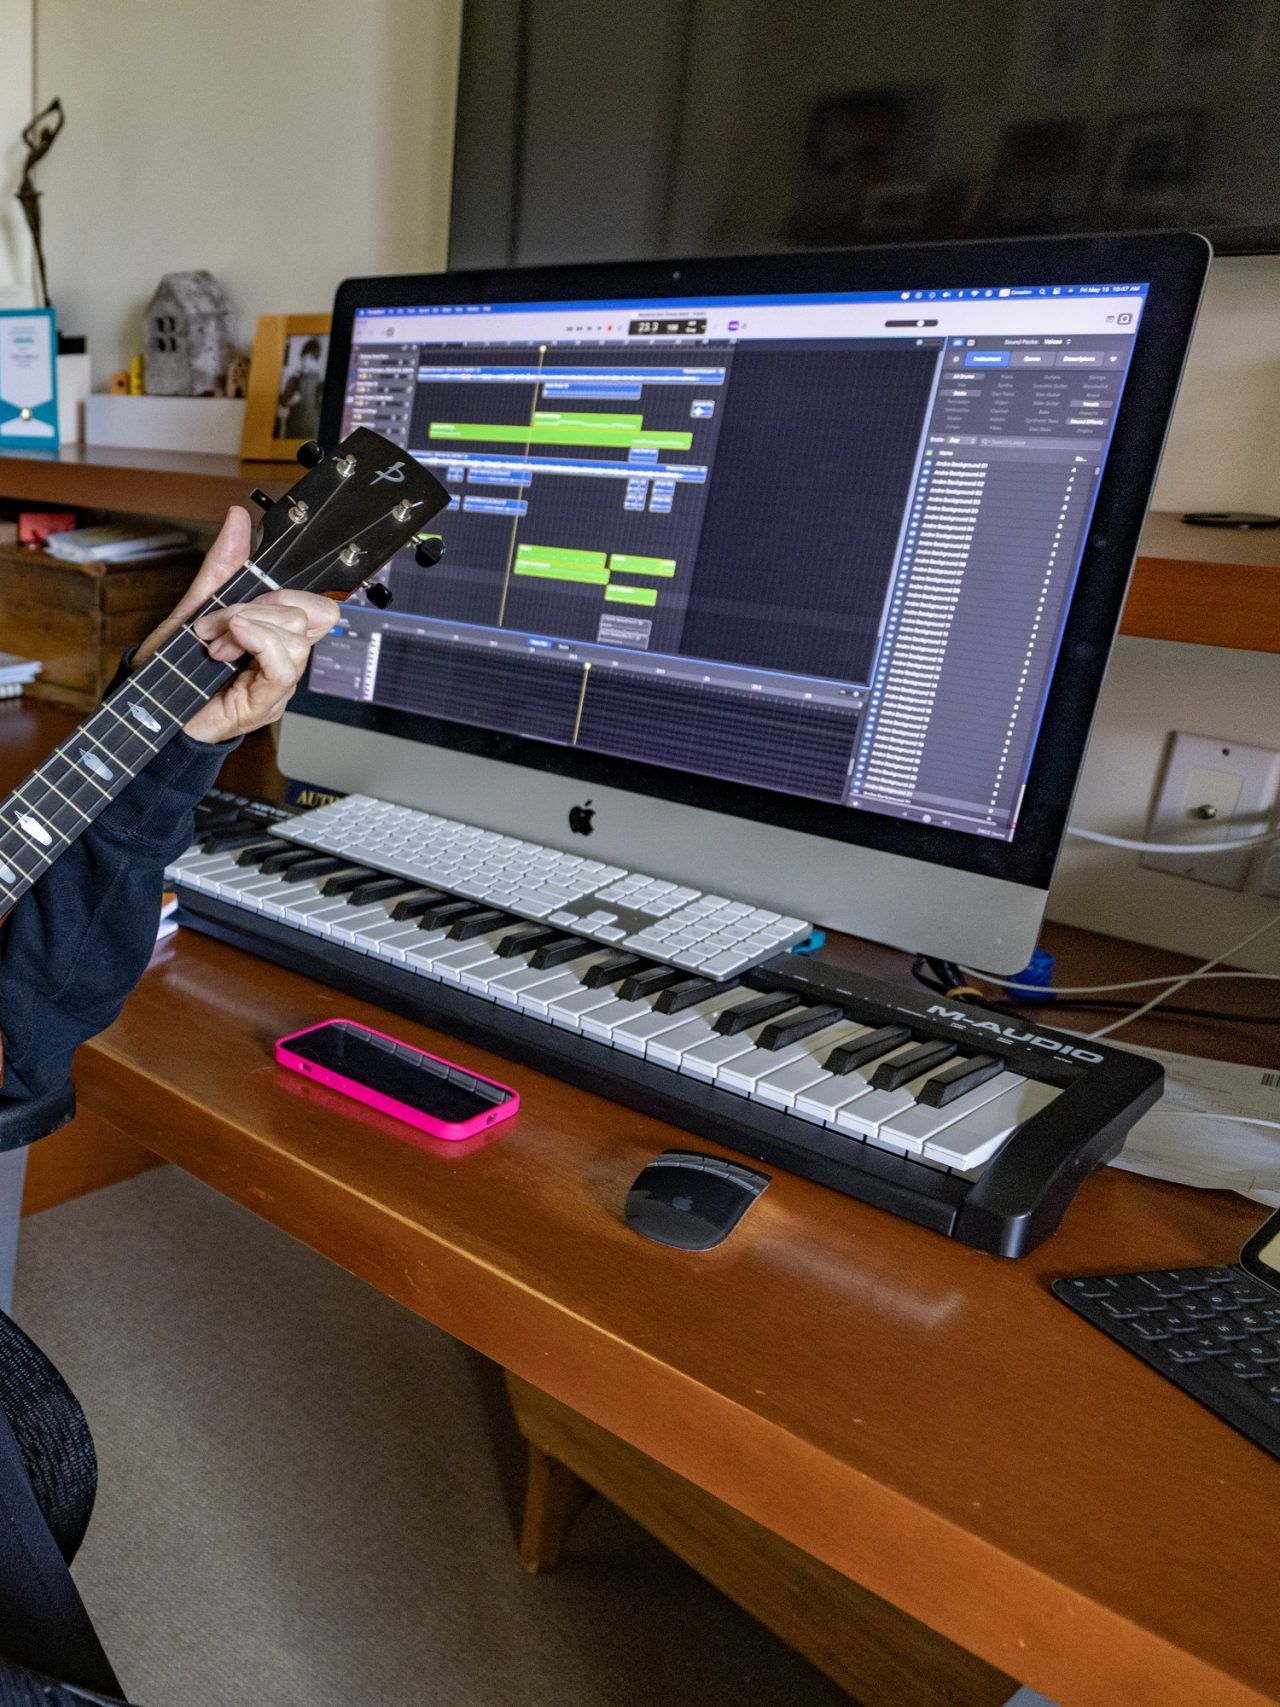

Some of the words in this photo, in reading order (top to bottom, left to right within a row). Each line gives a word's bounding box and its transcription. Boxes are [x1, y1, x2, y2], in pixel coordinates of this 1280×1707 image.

[951, 461, 981, 469] Background
[949, 470, 978, 478] Background
[947, 479, 976, 487] Background
[945, 488, 974, 496] Background
[943, 497, 972, 505] Background
[941, 506, 970, 514] Background
[939, 515, 968, 523] Background
[937, 524, 966, 532] Background
[935, 532, 964, 540] Background
[933, 541, 962, 549] Background
[931, 550, 960, 558] Background
[929, 559, 958, 567] Background
[927, 567, 956, 576] Background
[925, 576, 954, 585] Background
[923, 585, 952, 593] Background
[921, 593, 950, 602] Background
[919, 602, 948, 611] Background
[917, 610, 946, 619] Background
[915, 619, 944, 628] Background
[913, 627, 942, 637] Background
[912, 636, 940, 645] Background
[910, 644, 938, 654] Background
[908, 653, 936, 662] Background
[906, 661, 934, 671] Background
[904, 670, 932, 679] Background
[902, 678, 930, 688] Background
[900, 687, 928, 696] Background
[898, 695, 926, 705] Background
[896, 703, 924, 713] Background
[895, 712, 922, 722] Background
[893, 720, 921, 730] Background
[891, 728, 919, 738] Background
[889, 736, 917, 747] Background
[887, 745, 915, 755] Background
[885, 753, 913, 763] Background
[883, 761, 911, 772] Background
[868, 766, 881, 774] Andre
[882, 769, 909, 780] Background
[866, 774, 879, 782] Andre
[880, 777, 907, 788] Background
[878, 785, 905, 796] Background
[927, 1005, 1105, 1064] M-AUDIO
